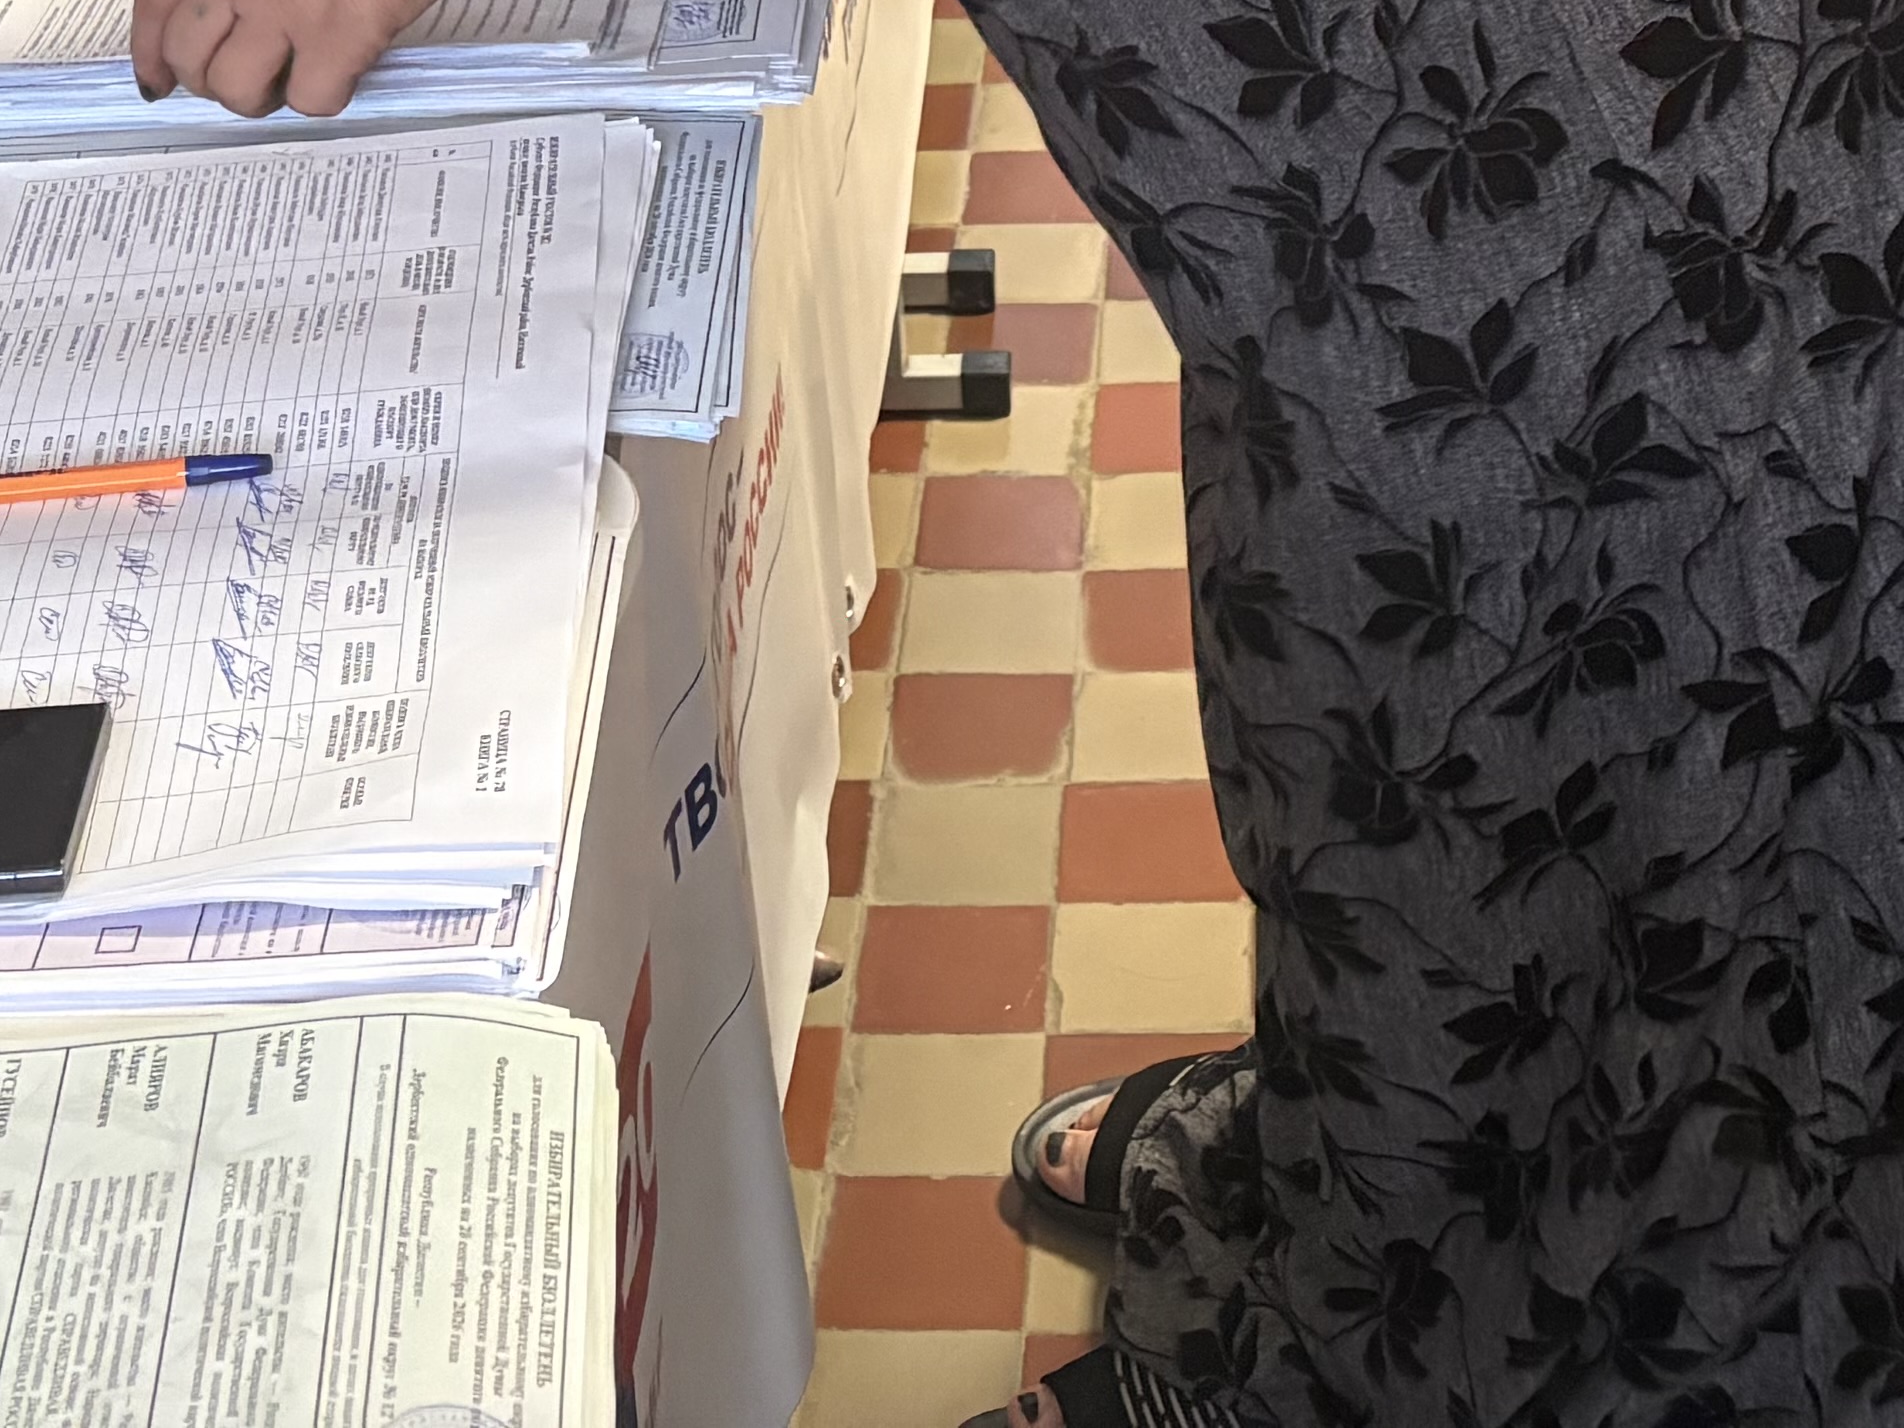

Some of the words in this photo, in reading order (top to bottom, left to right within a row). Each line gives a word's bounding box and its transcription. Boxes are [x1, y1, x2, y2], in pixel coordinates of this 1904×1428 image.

[478, 735, 491, 770] КНИГА
[495, 710, 511, 764] СТРАНИЦА
[126, 1045, 147, 1086] Марат
[143, 1044, 168, 1112] АЛИЯРОВ
[293, 1029, 315, 1102] АБАКАРОВ
[419, 1167, 437, 1236] Республика
[544, 1130, 565, 1270] ИЗБИРАТЕЛЬНЫЙ
[452, 1301, 466, 1332] 2026
[536, 1273, 558, 1388] БЮЛЛЕТЕНЬ
